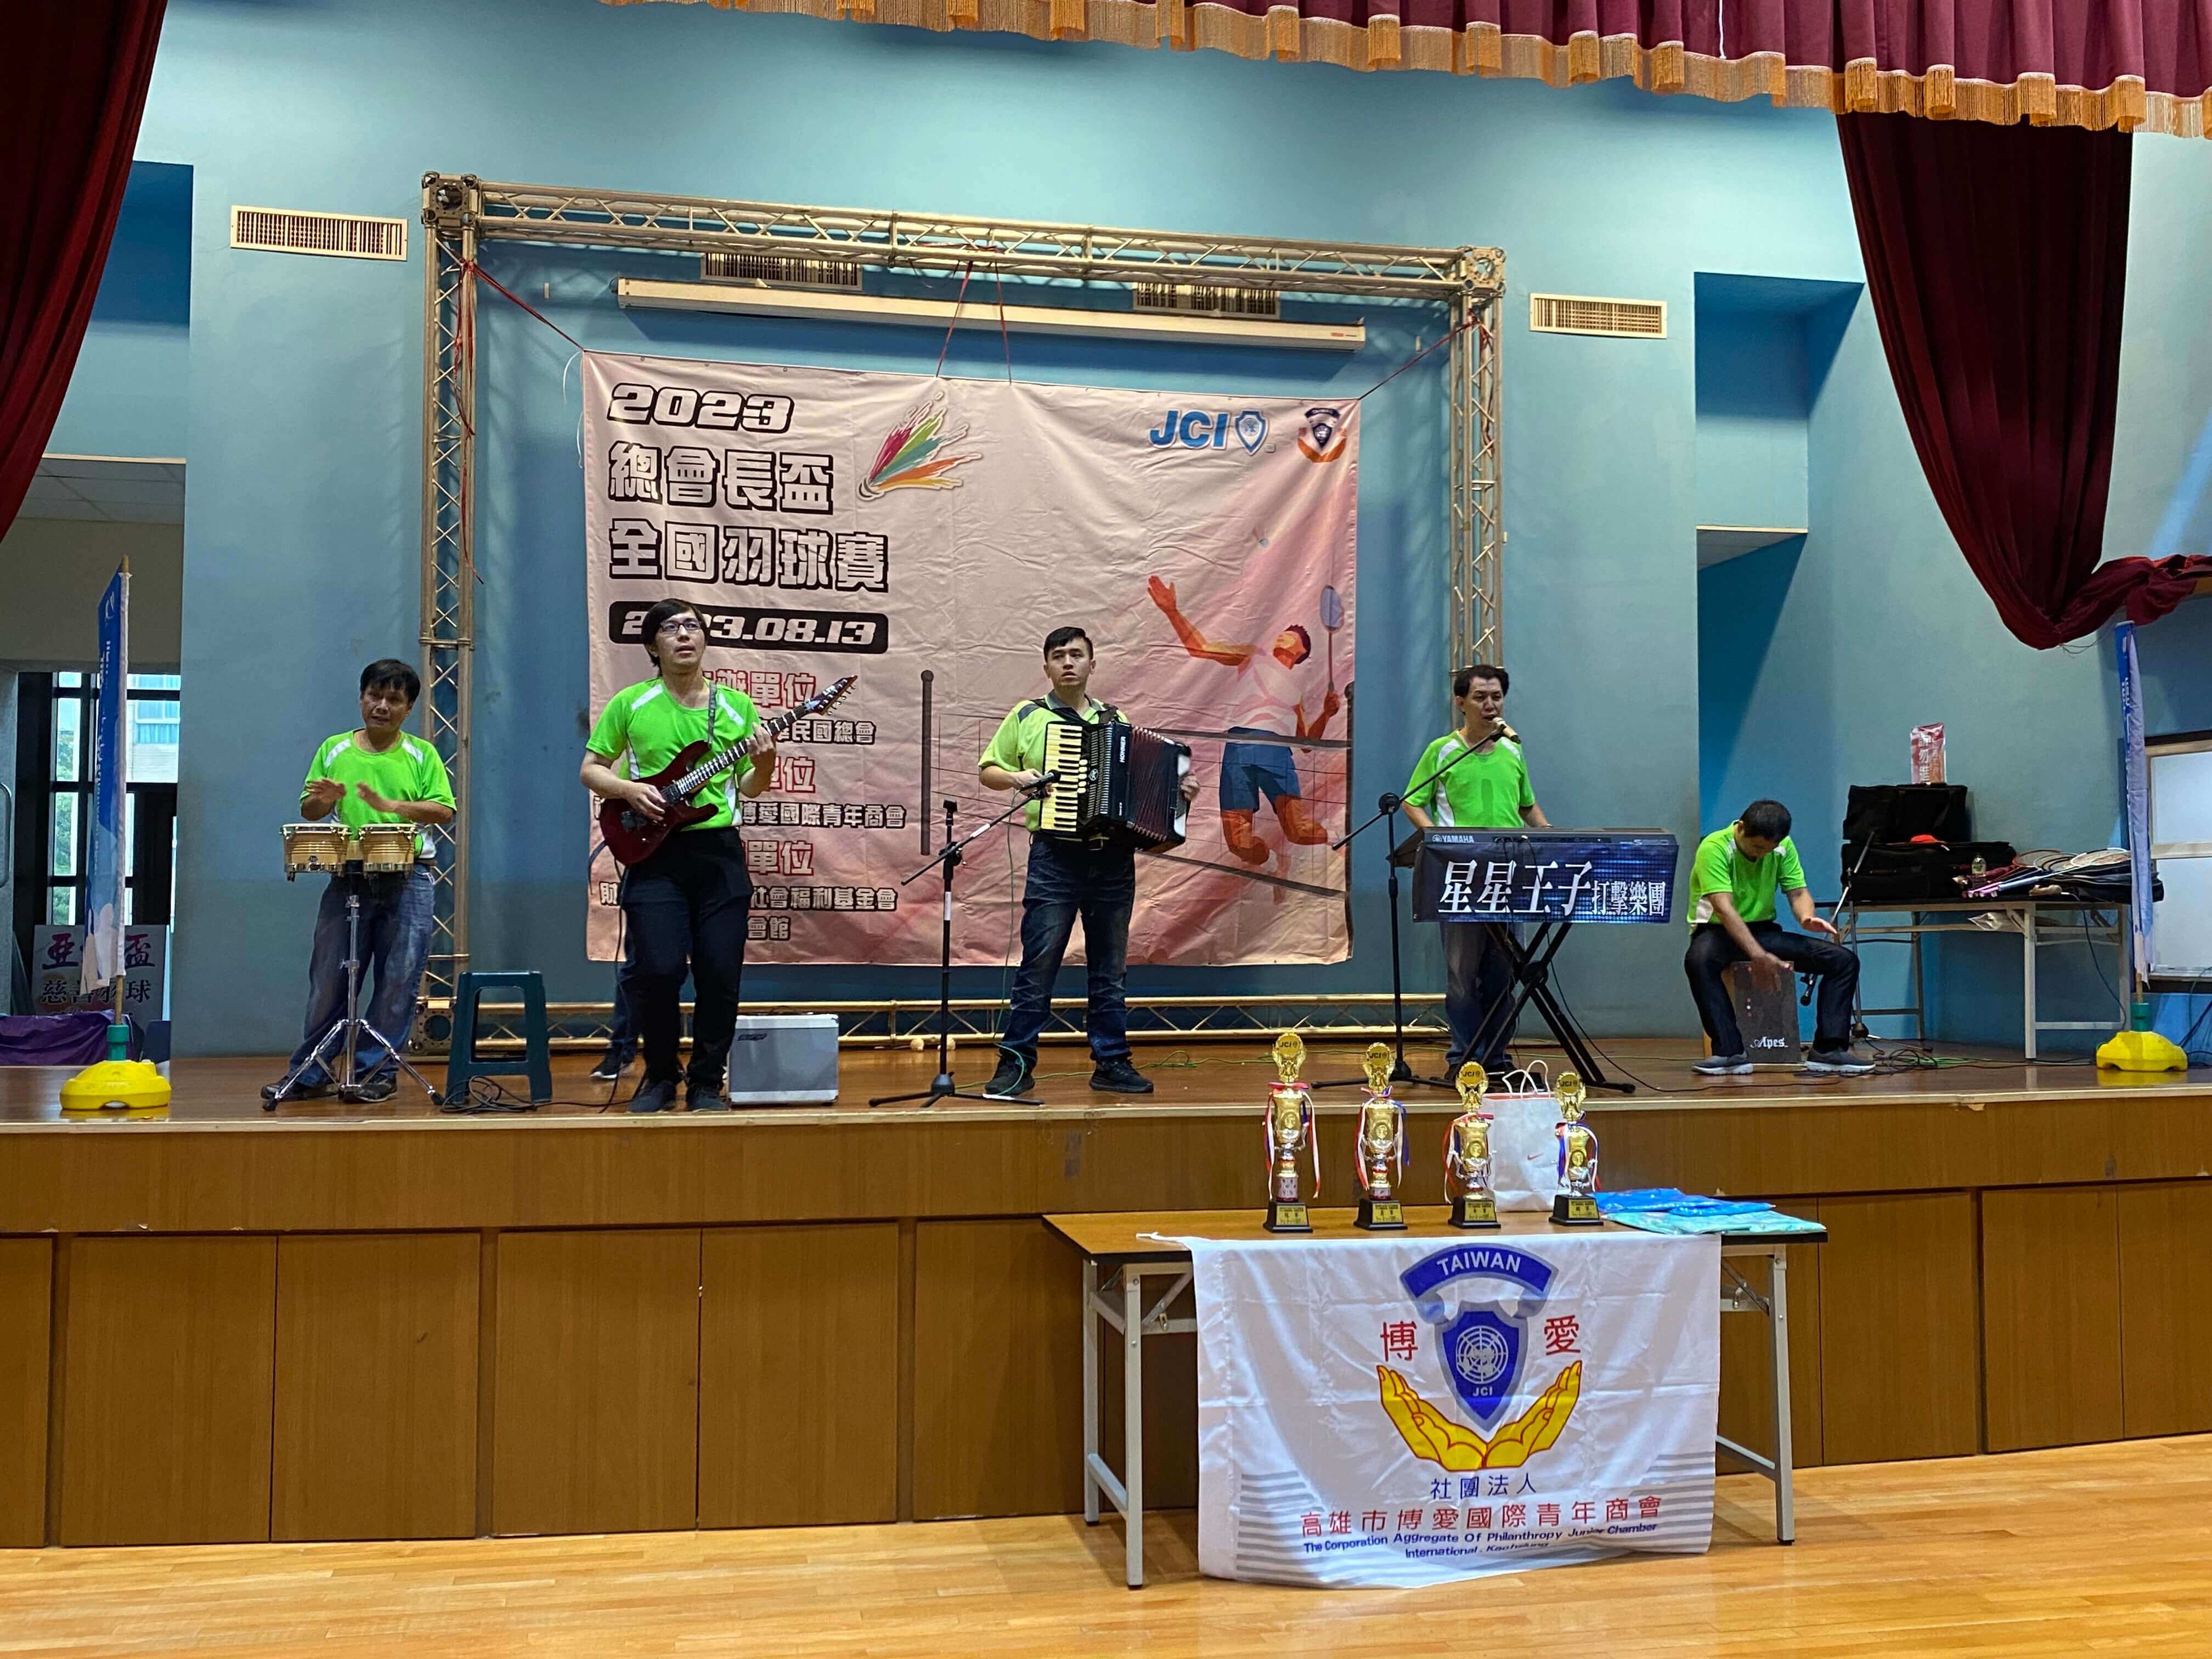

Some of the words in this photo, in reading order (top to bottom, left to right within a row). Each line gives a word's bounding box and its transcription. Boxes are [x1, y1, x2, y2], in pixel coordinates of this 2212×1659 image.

[607, 382, 794, 433] 2023
[1149, 409, 1229, 449] JCI
[608, 441, 833, 515] 總會長盃
[608, 518, 889, 592] 全國羽球賽
[622, 611, 877, 645] 23.08.13
[759, 716, 877, 744] 民國總會
[1442, 835, 1475, 843] YAMAHA
[742, 839, 814, 876] 單位
[42, 933, 156, 969] 亞盃
[1436, 1251, 1521, 1276] TAIWAN
[1472, 1386, 1493, 1397] JCI
[1304, 1541, 1323, 1554] The
[1325, 1536, 1388, 1551] Corporation
[1393, 1533, 1459, 1544] Aggregate
[1465, 1533, 1482, 1542] Of
[1487, 1531, 1562, 1542] Philanthropy
[1568, 1527, 1604, 1537] Junior
[1607, 1523, 1658, 1534] Chamber
